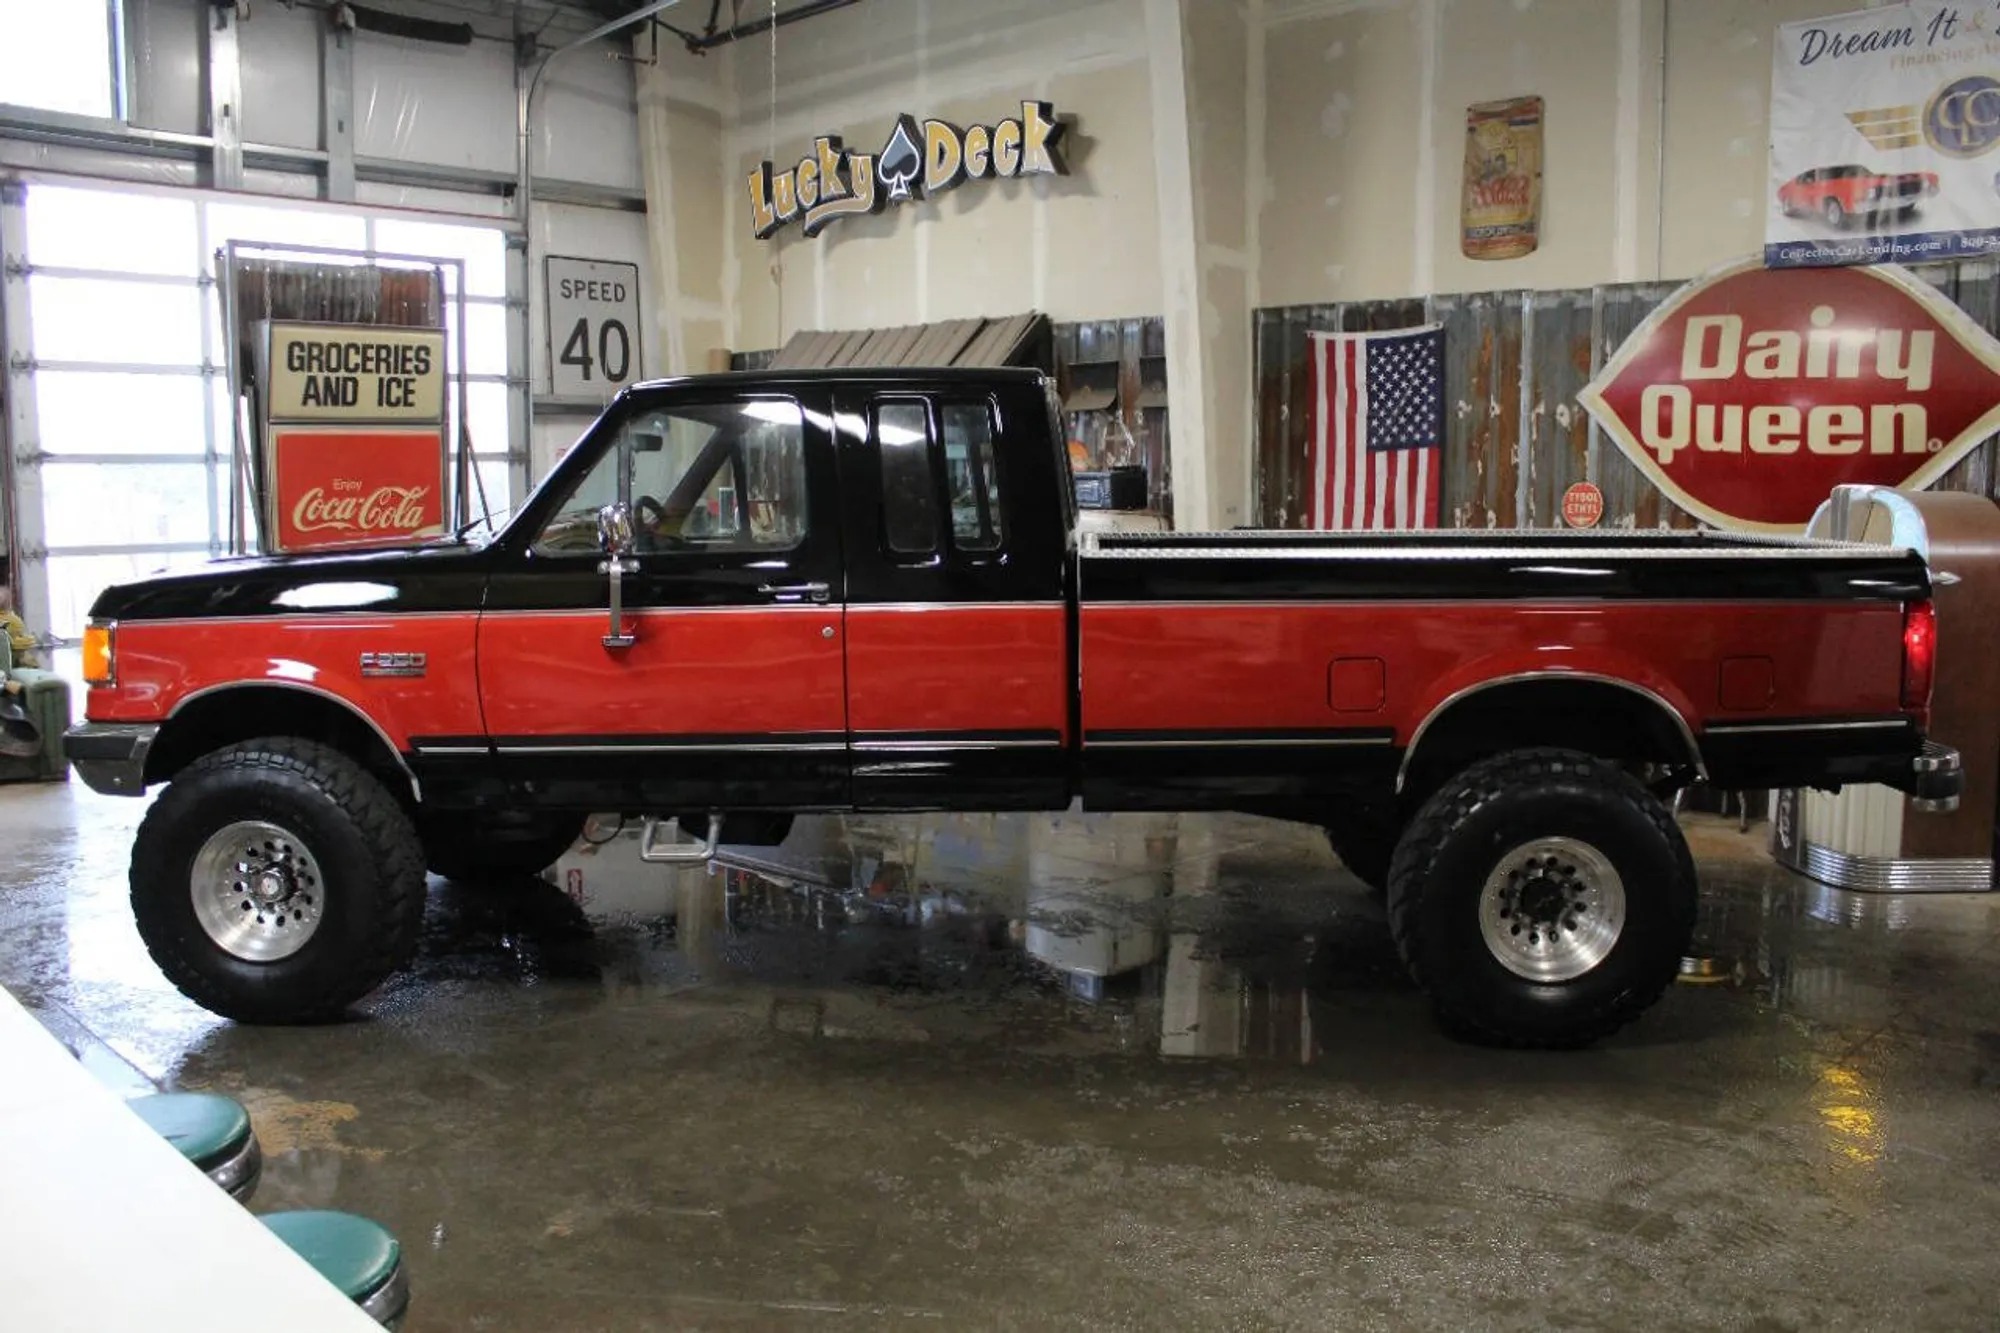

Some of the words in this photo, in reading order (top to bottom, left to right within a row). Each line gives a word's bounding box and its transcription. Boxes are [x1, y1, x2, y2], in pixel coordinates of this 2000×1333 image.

[1800, 28, 1915, 66] Dream
[1926, 7, 1960, 47] It
[748, 135, 880, 239] Lucky
[923, 100, 1067, 191] Deck
[560, 279, 626, 302] SPEED
[287, 341, 431, 375] GROCERIES
[560, 317, 629, 382] 40
[1680, 305, 1935, 391] Dairy
[302, 375, 359, 407] AND
[377, 376, 416, 407] ICE
[1640, 384, 1928, 465] Queen
[292, 485, 431, 533] Coca-Cola
[332, 478, 362, 492] Enjoy
